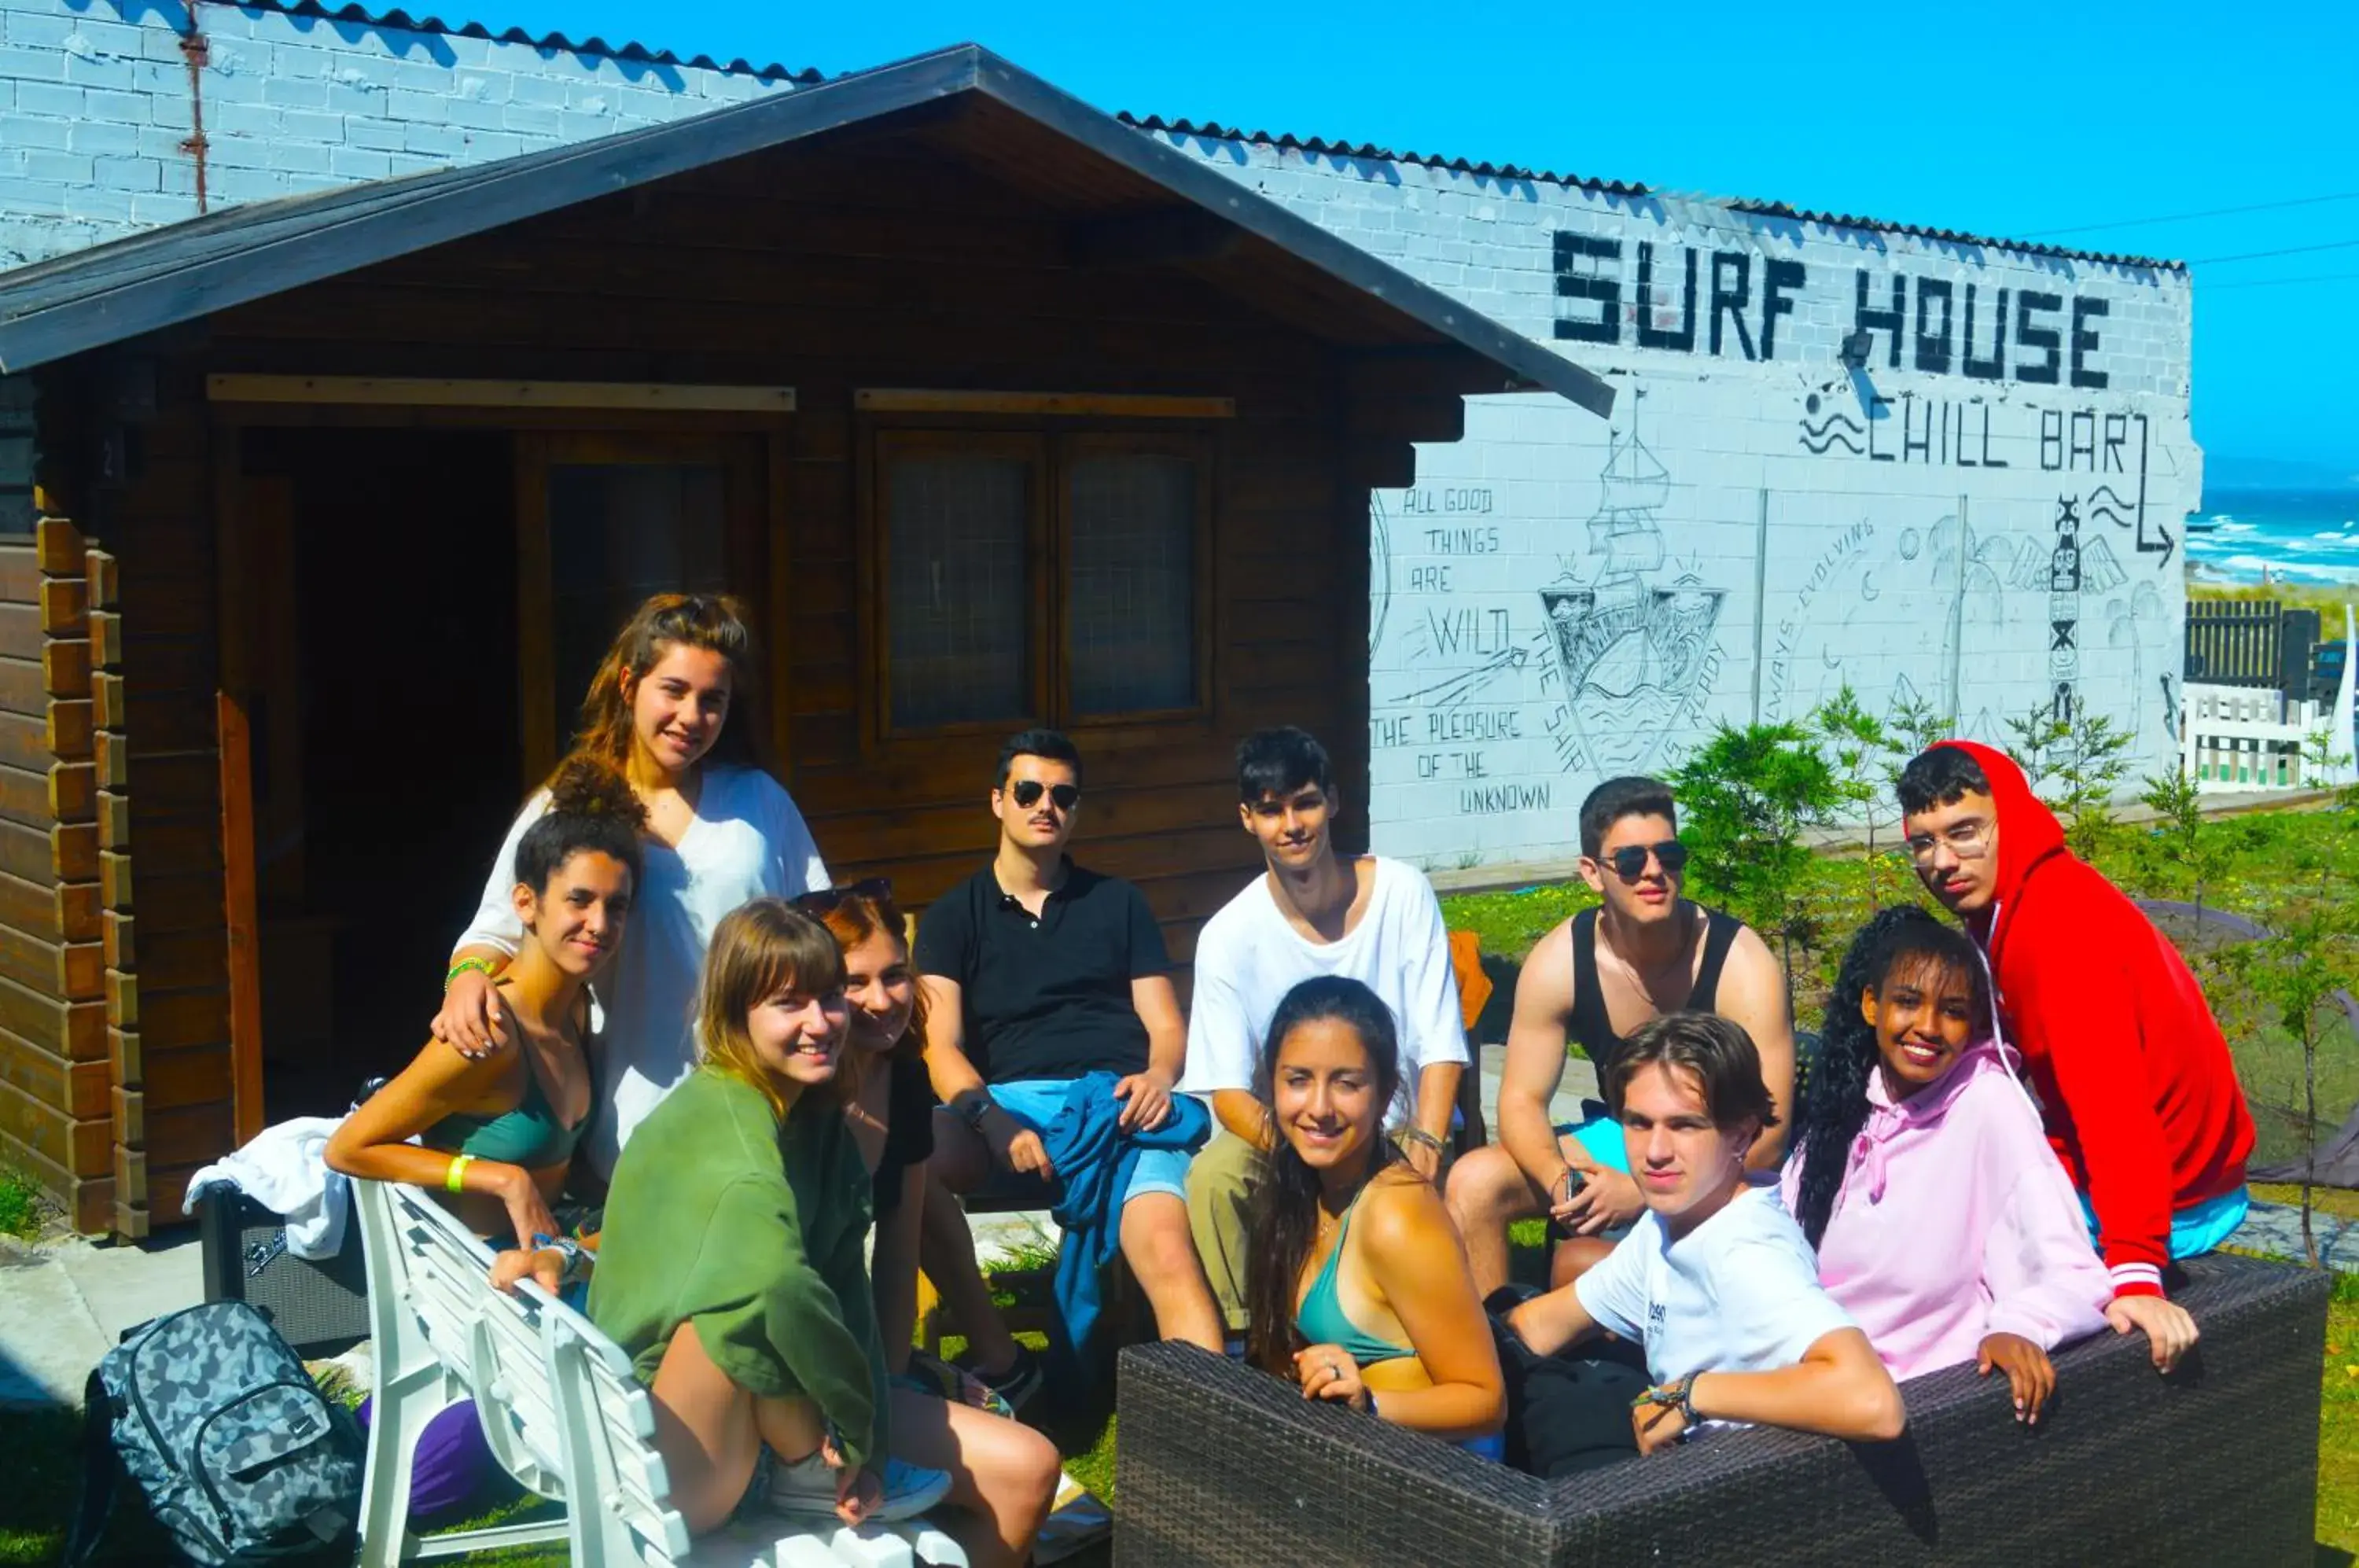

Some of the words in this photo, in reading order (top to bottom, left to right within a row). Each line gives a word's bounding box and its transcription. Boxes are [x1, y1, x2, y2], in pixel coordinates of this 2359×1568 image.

[1553, 230, 1806, 361] SURF
[1855, 267, 2109, 388] HOUSE
[1870, 396, 2008, 466] CHILL
[2041, 409, 2127, 473] BAR
[1404, 488, 1436, 513] ALL
[1444, 488, 1492, 513] GOOD
[1424, 526, 1499, 554] THINGS
[1411, 565, 1453, 592] ARE
[1532, 620, 1559, 695] THE
[1370, 716, 1412, 747] THE
[1427, 711, 1522, 742] PLEASURE
[1544, 705, 1586, 773] SHIP
[1418, 753, 1442, 778] OF
[1448, 750, 1489, 778] THE
[1459, 779, 1550, 813] UNKNOWN
